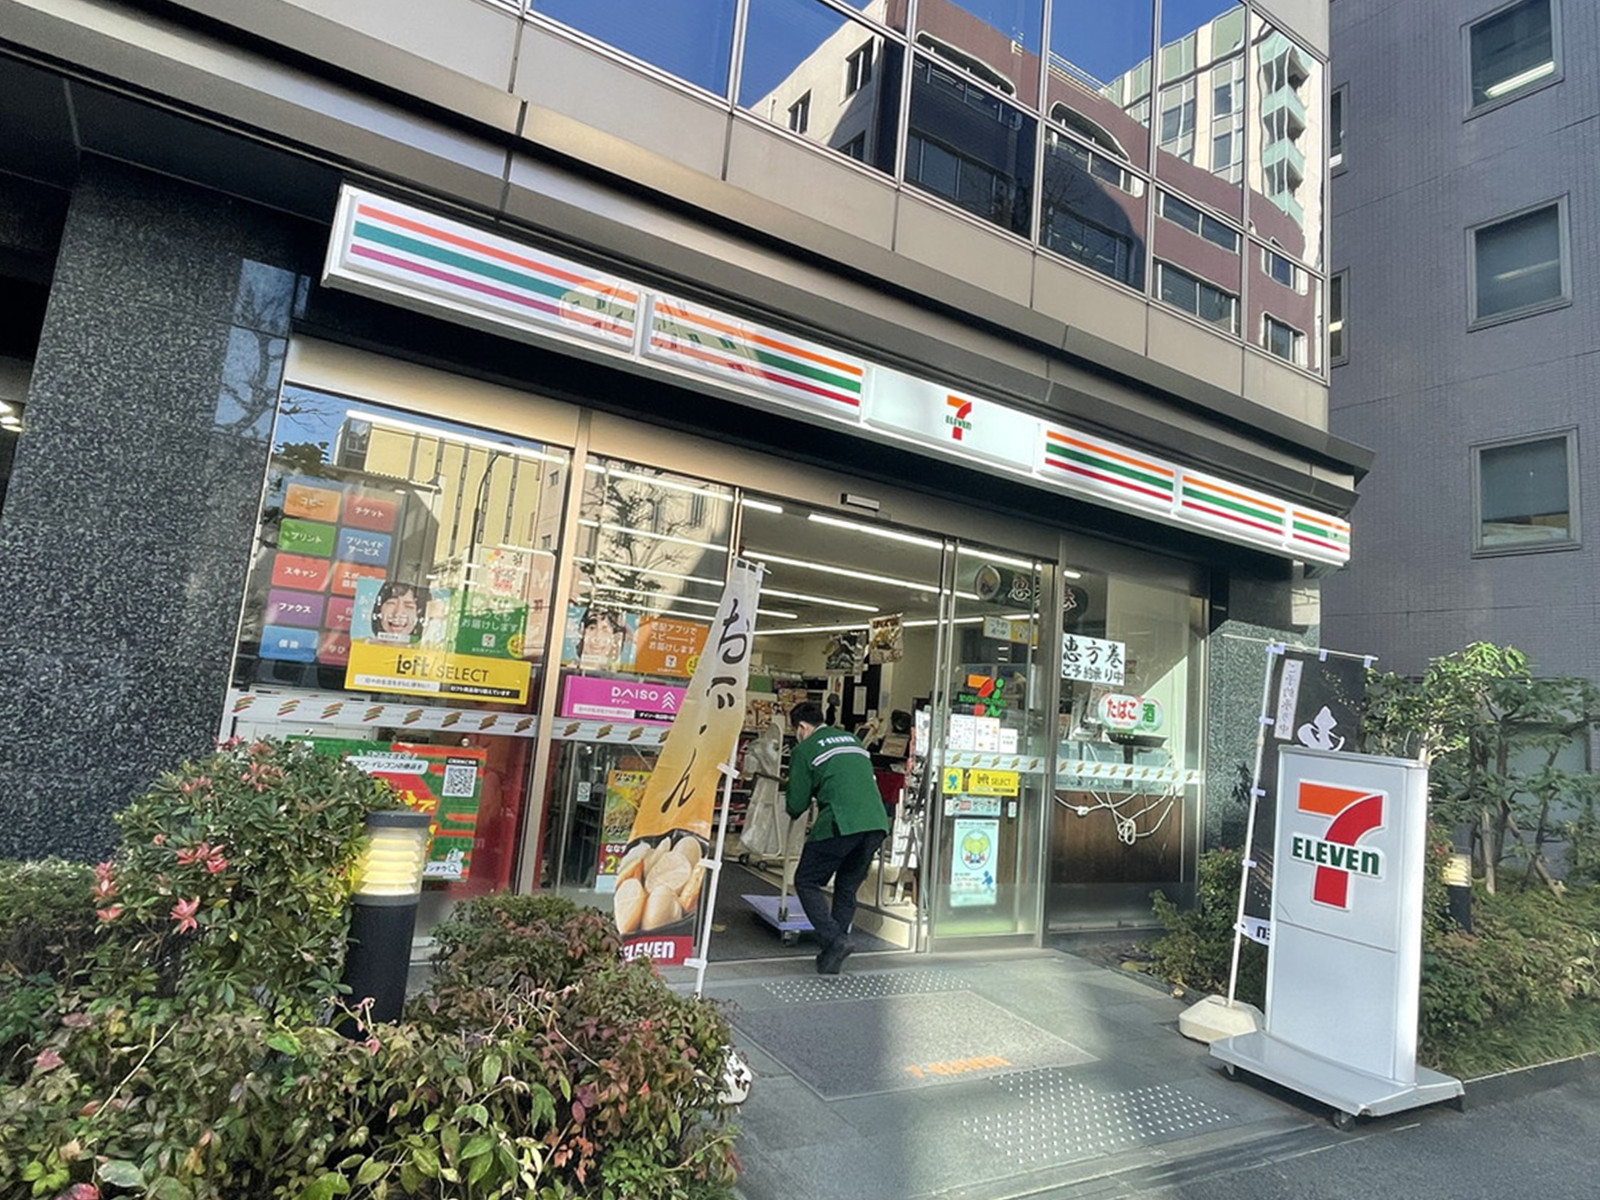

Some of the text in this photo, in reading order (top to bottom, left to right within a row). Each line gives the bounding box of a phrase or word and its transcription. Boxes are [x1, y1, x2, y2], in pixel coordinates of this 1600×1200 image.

[355, 506, 385, 518] チケット
[290, 531, 322, 544] プリント
[284, 566, 318, 579] スキャン
[278, 602, 312, 614] ファクス
[1063, 635, 1123, 669] 恵方巻
[436, 664, 489, 682] SELECT
[611, 686, 659, 702] DAISO
[1107, 699, 1137, 720] たばこ
[1142, 703, 1156, 723] 酒
[1298, 781, 1384, 908] 7
